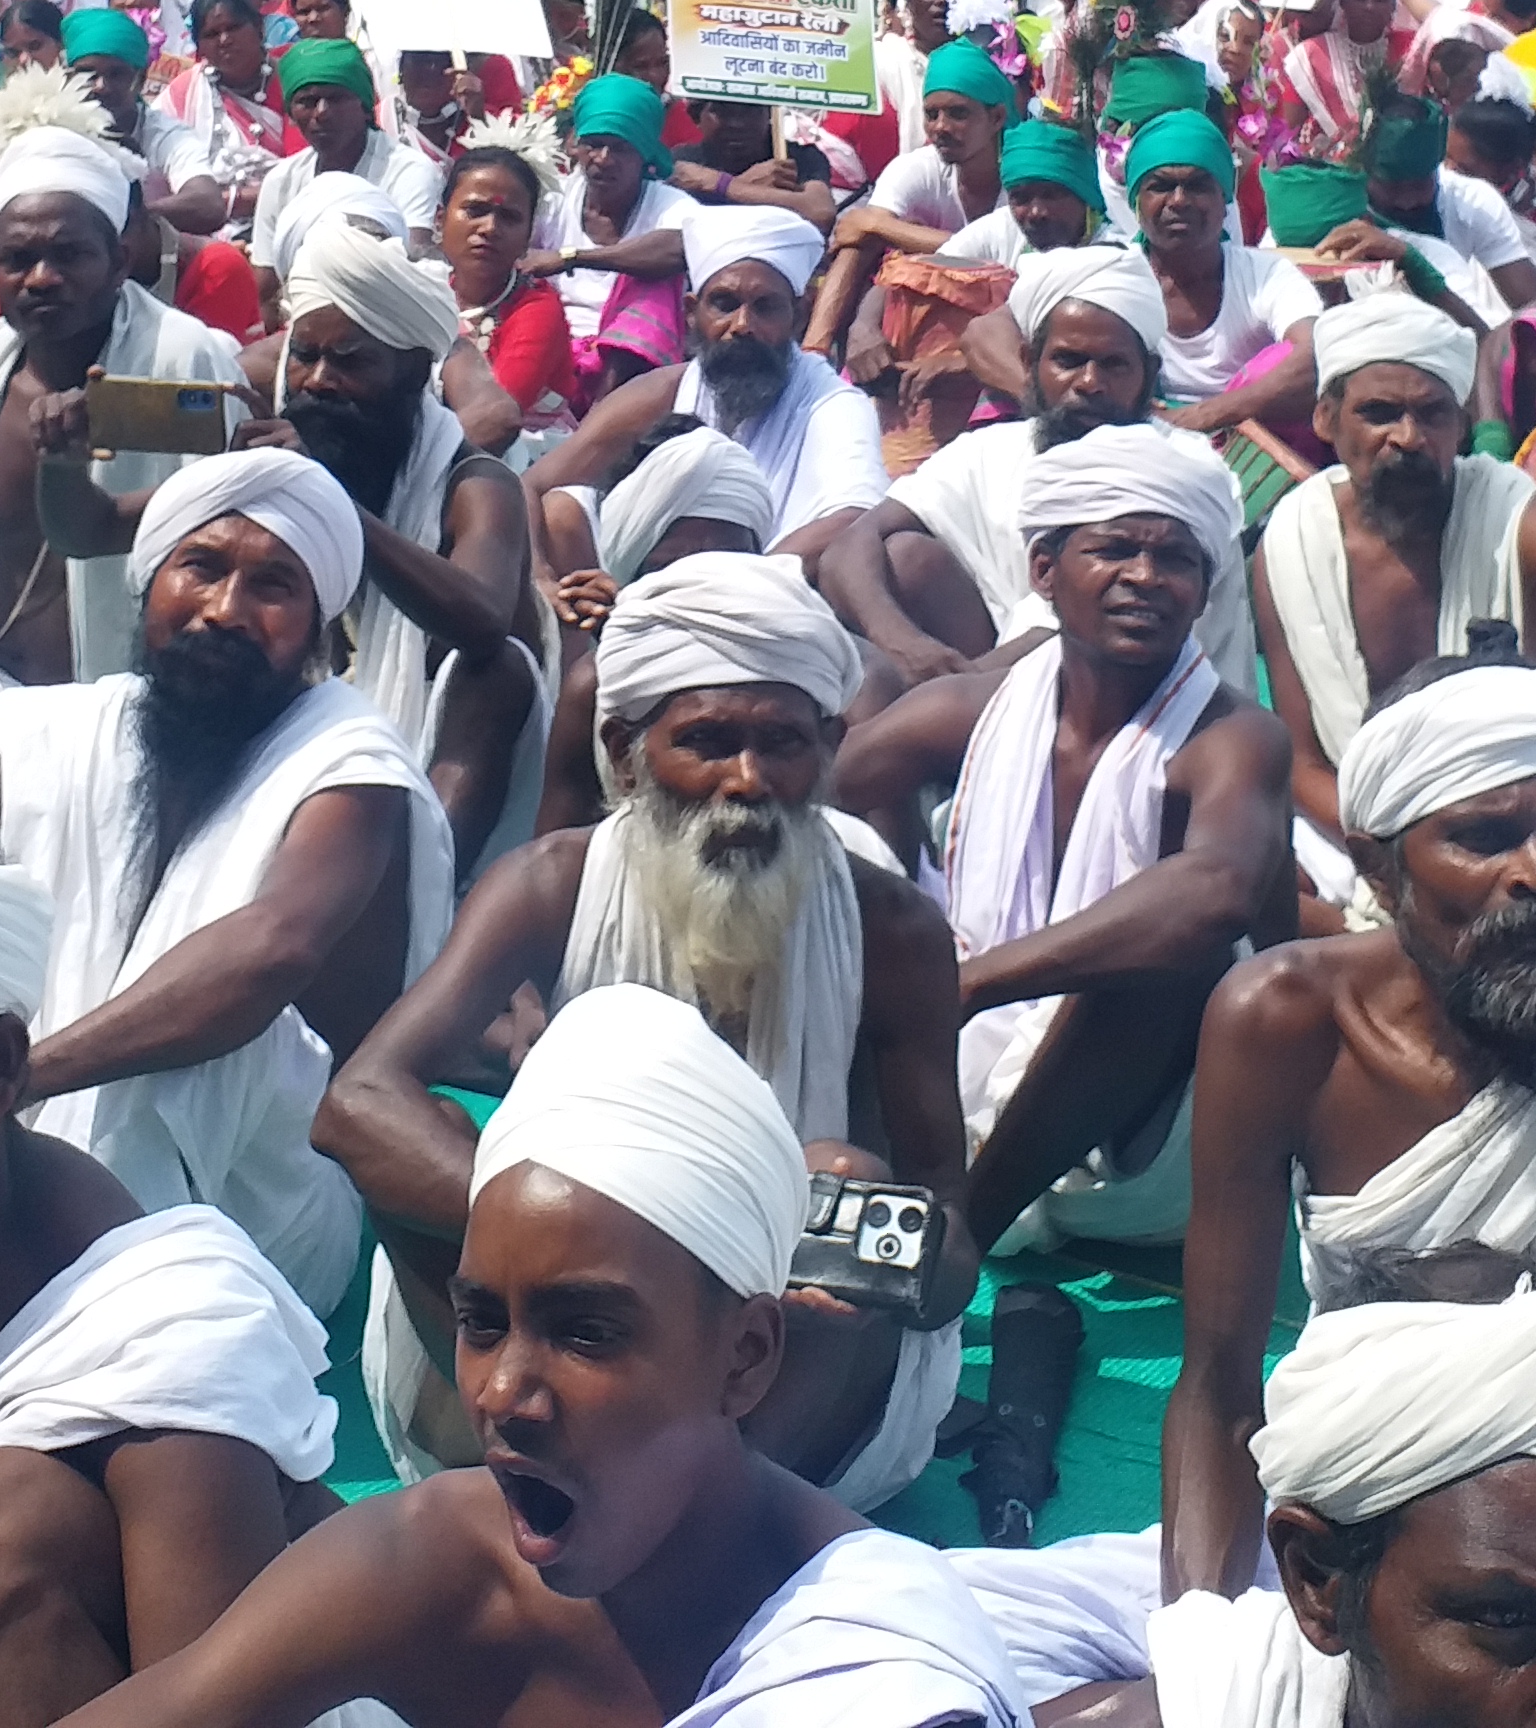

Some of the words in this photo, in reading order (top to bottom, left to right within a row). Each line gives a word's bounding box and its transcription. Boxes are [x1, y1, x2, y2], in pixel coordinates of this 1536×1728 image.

[700, 29, 779, 52] आदिवासियों
[782, 38, 800, 54] का
[805, 39, 846, 59] जमीन
[724, 56, 764, 76] लूटना
[768, 57, 787, 76] बंद
